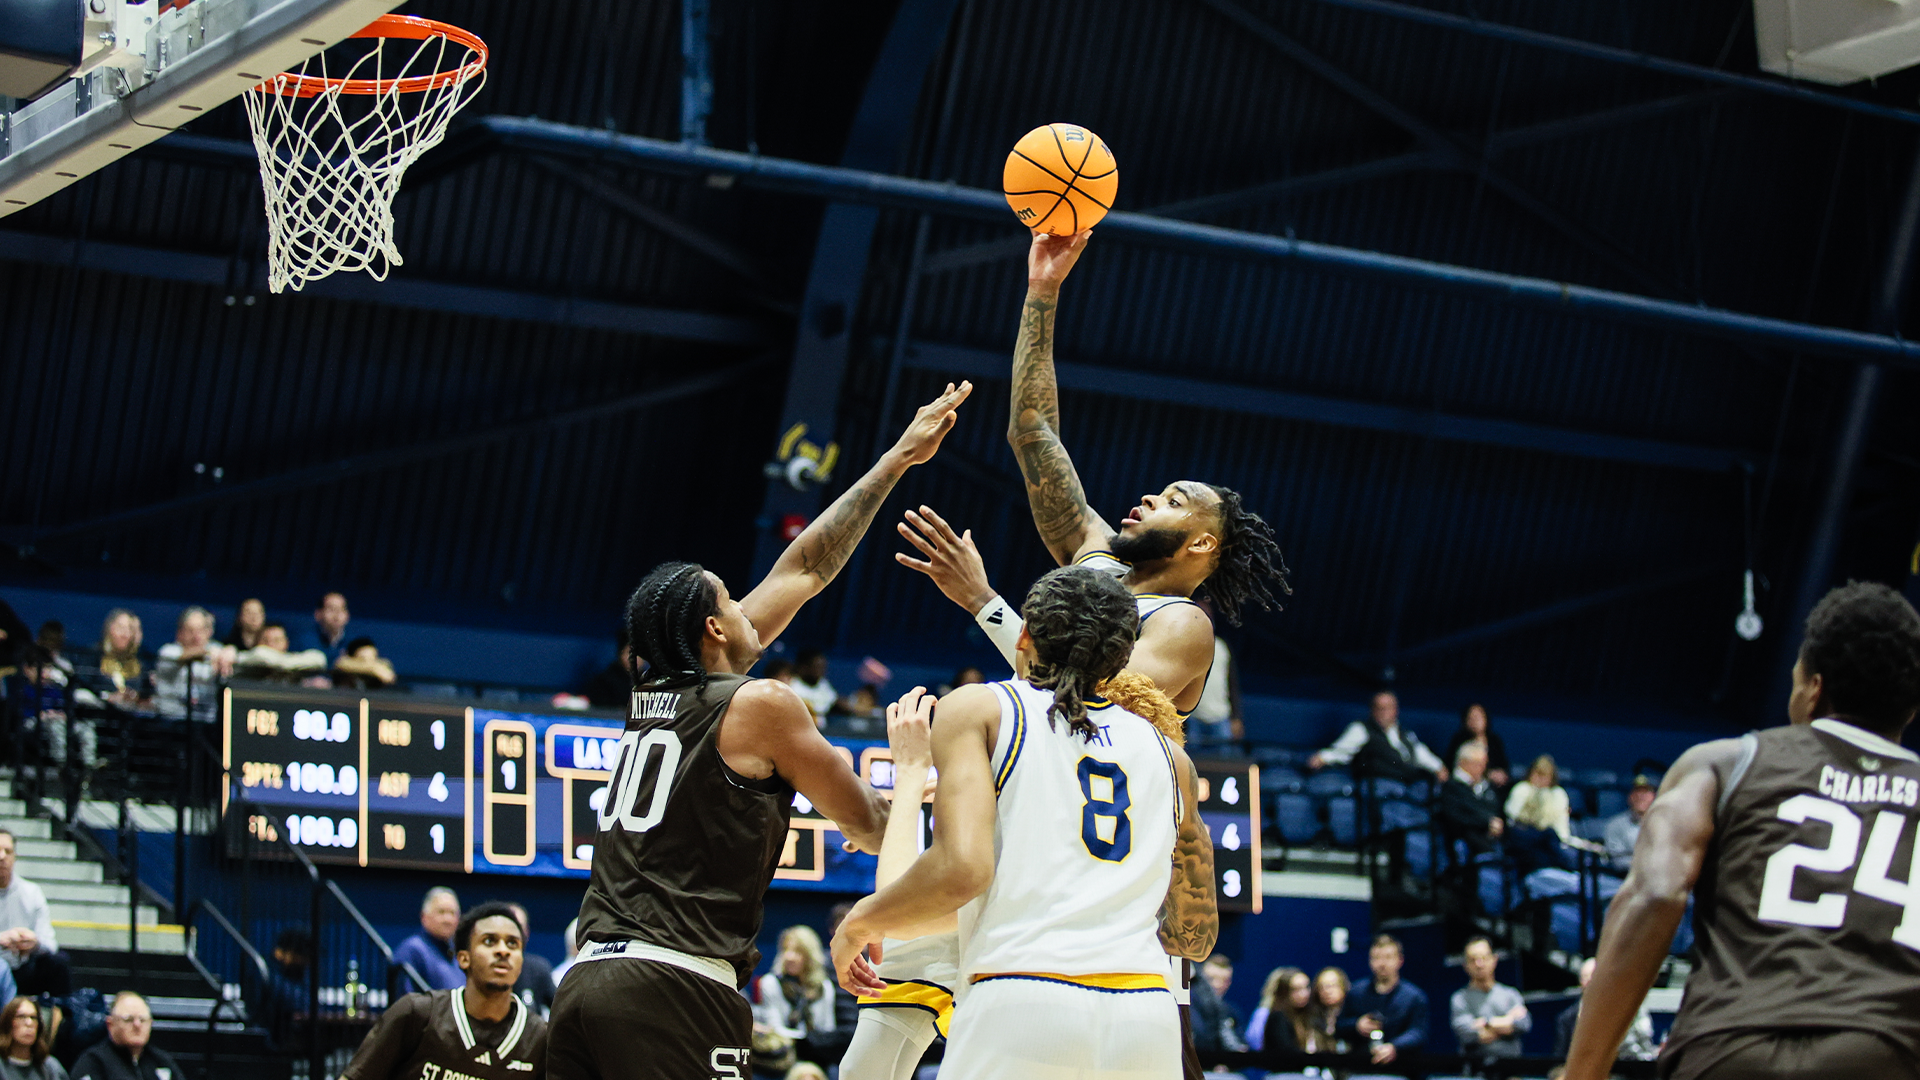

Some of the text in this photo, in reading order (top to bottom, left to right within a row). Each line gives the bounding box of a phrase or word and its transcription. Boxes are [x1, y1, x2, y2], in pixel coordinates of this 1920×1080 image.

[631, 691, 682, 719] MITCHELL
[430, 719, 446, 751] 1
[286, 761, 358, 796] 100.0
[500, 760, 517, 791] 1
[599, 728, 683, 833] 00
[1818, 764, 1919, 808] CHARLES
[1076, 754, 1133, 865] 8
[286, 814, 358, 849] 100.0
[429, 823, 446, 854] 1
[1757, 793, 1920, 954] 24
